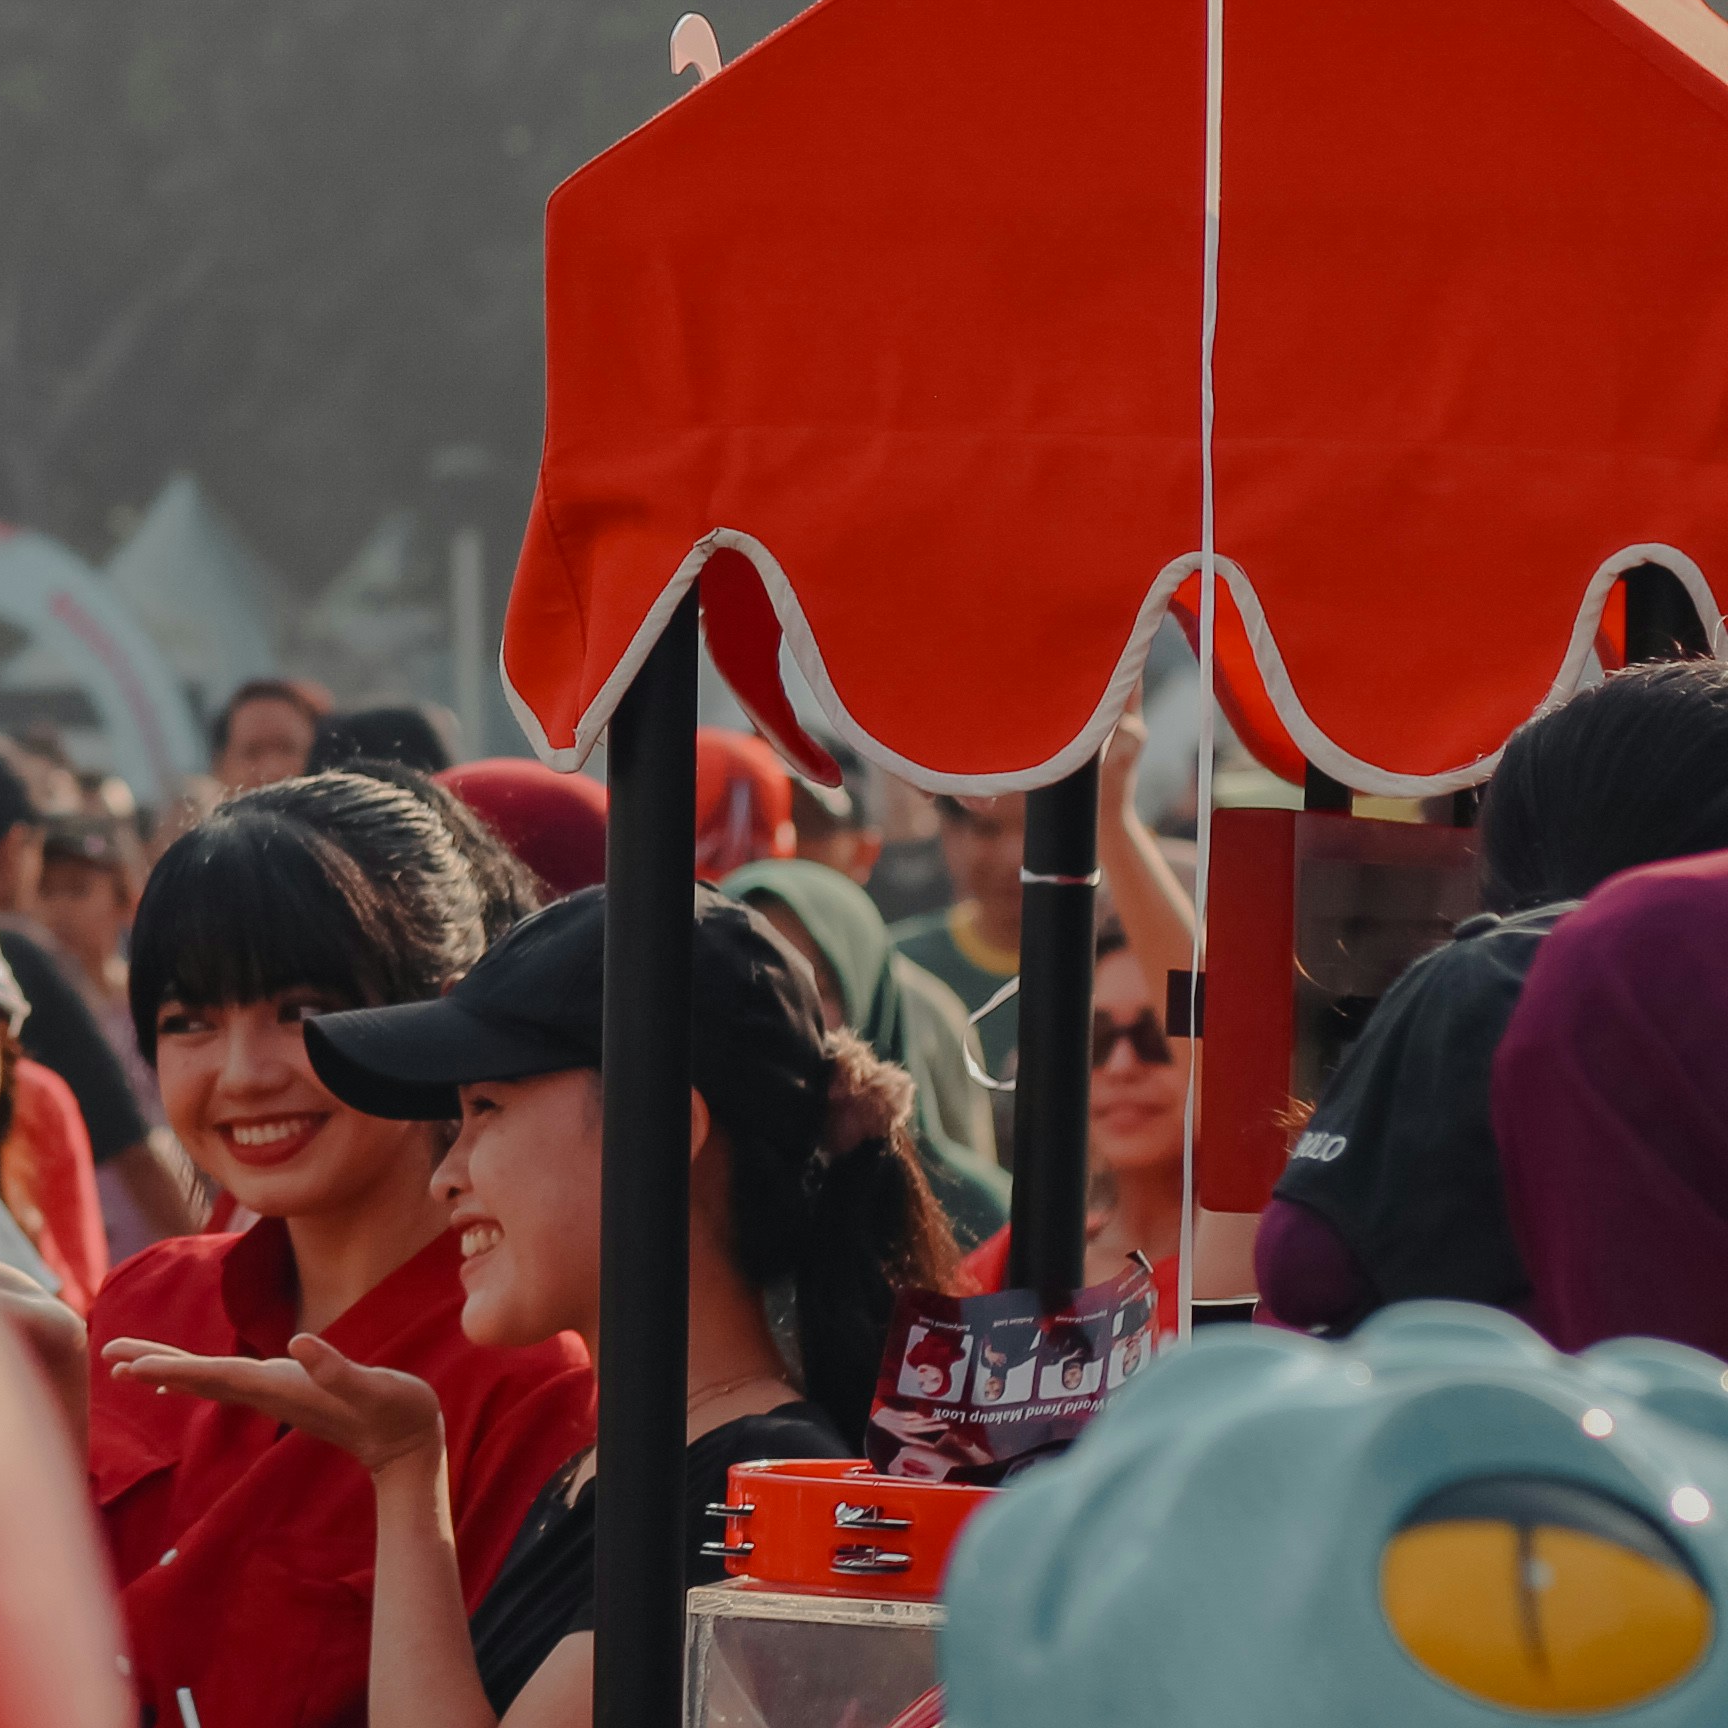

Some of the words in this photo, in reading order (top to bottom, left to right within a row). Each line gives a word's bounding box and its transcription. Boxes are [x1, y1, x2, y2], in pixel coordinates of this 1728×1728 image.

[932, 1407, 966, 1424] Look
[969, 1408, 1024, 1425] Makeup
[1025, 1402, 1062, 1420] Trend
[1062, 1399, 1105, 1417] World
